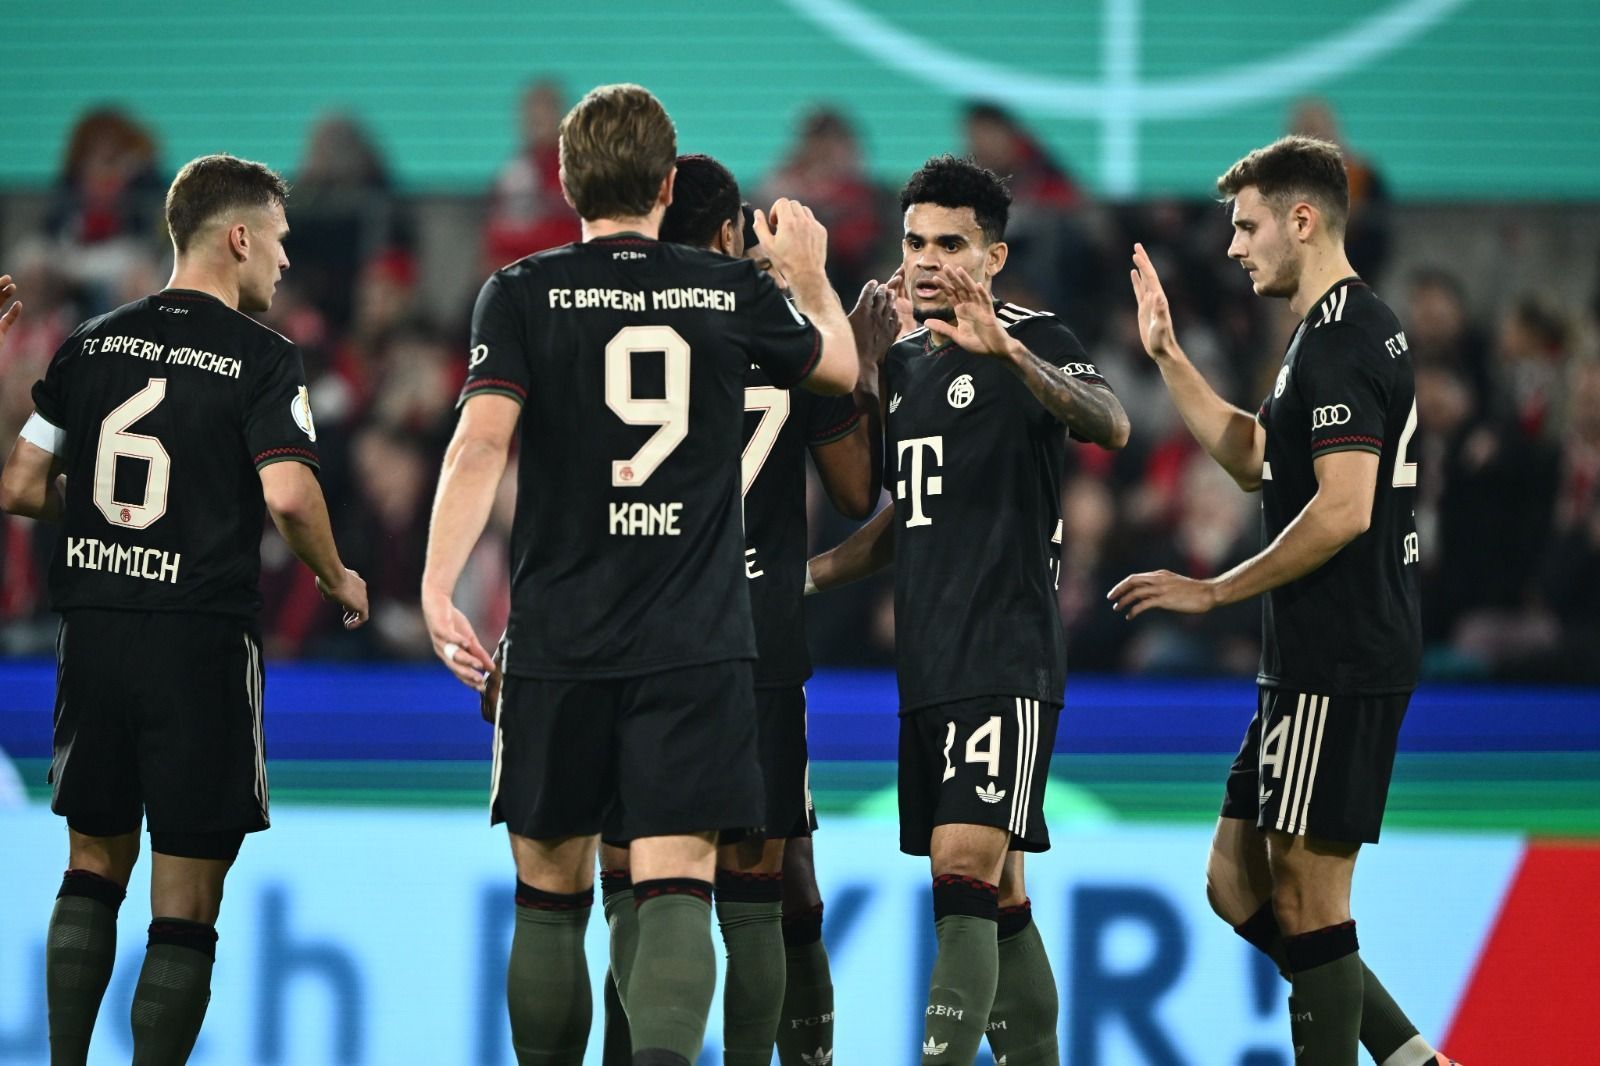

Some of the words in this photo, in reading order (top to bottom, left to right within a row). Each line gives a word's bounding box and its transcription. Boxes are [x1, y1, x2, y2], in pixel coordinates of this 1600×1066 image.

[549, 288, 572, 309] FC
[575, 288, 646, 312] BAYERN
[81, 338, 100, 356] FC
[101, 336, 165, 361] BAYERN
[605, 325, 691, 487] 9
[93, 378, 171, 530] 6
[897, 436, 943, 528] T
[609, 502, 683, 536] KANE
[66, 537, 181, 584] KIMMICH
[942, 716, 1002, 783] 14
[791, 1011, 834, 1029] FCB
[925, 1004, 963, 1020] CBM
